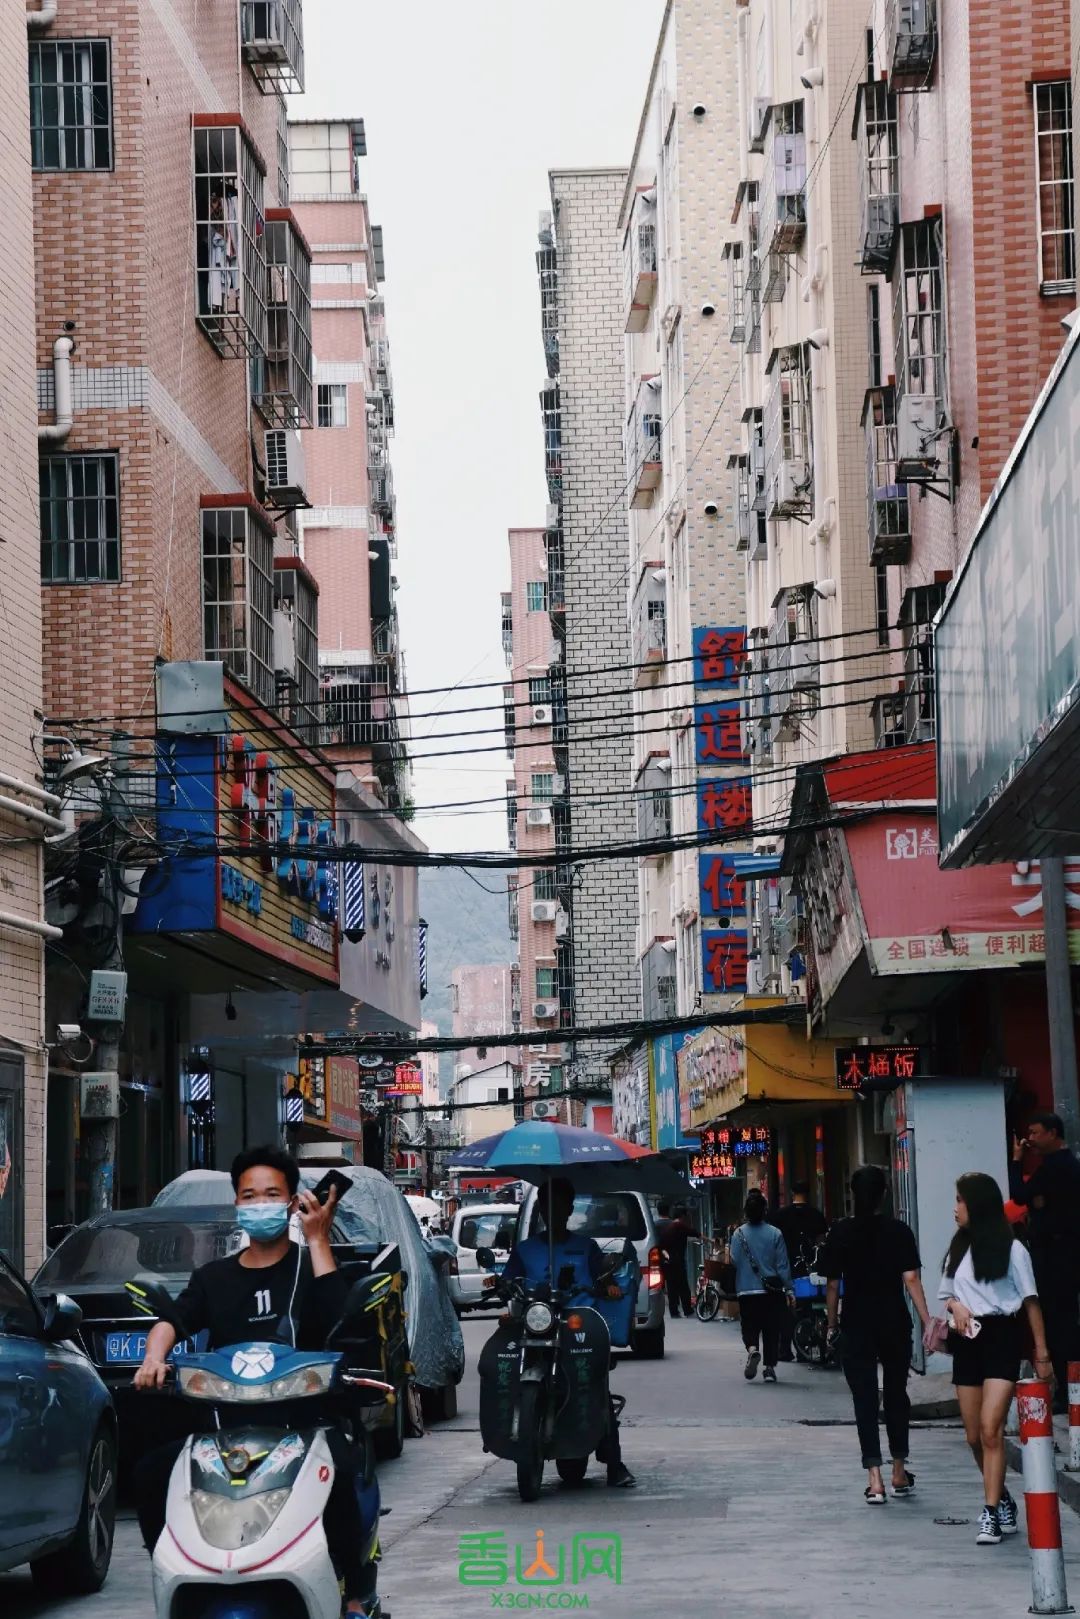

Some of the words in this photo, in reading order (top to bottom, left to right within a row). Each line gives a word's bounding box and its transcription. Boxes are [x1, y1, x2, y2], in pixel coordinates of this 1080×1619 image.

[698, 630, 752, 988] 舒适楼住宿
[887, 938, 970, 961] 全国连锁
[844, 1053, 915, 1084] 木桶饭
